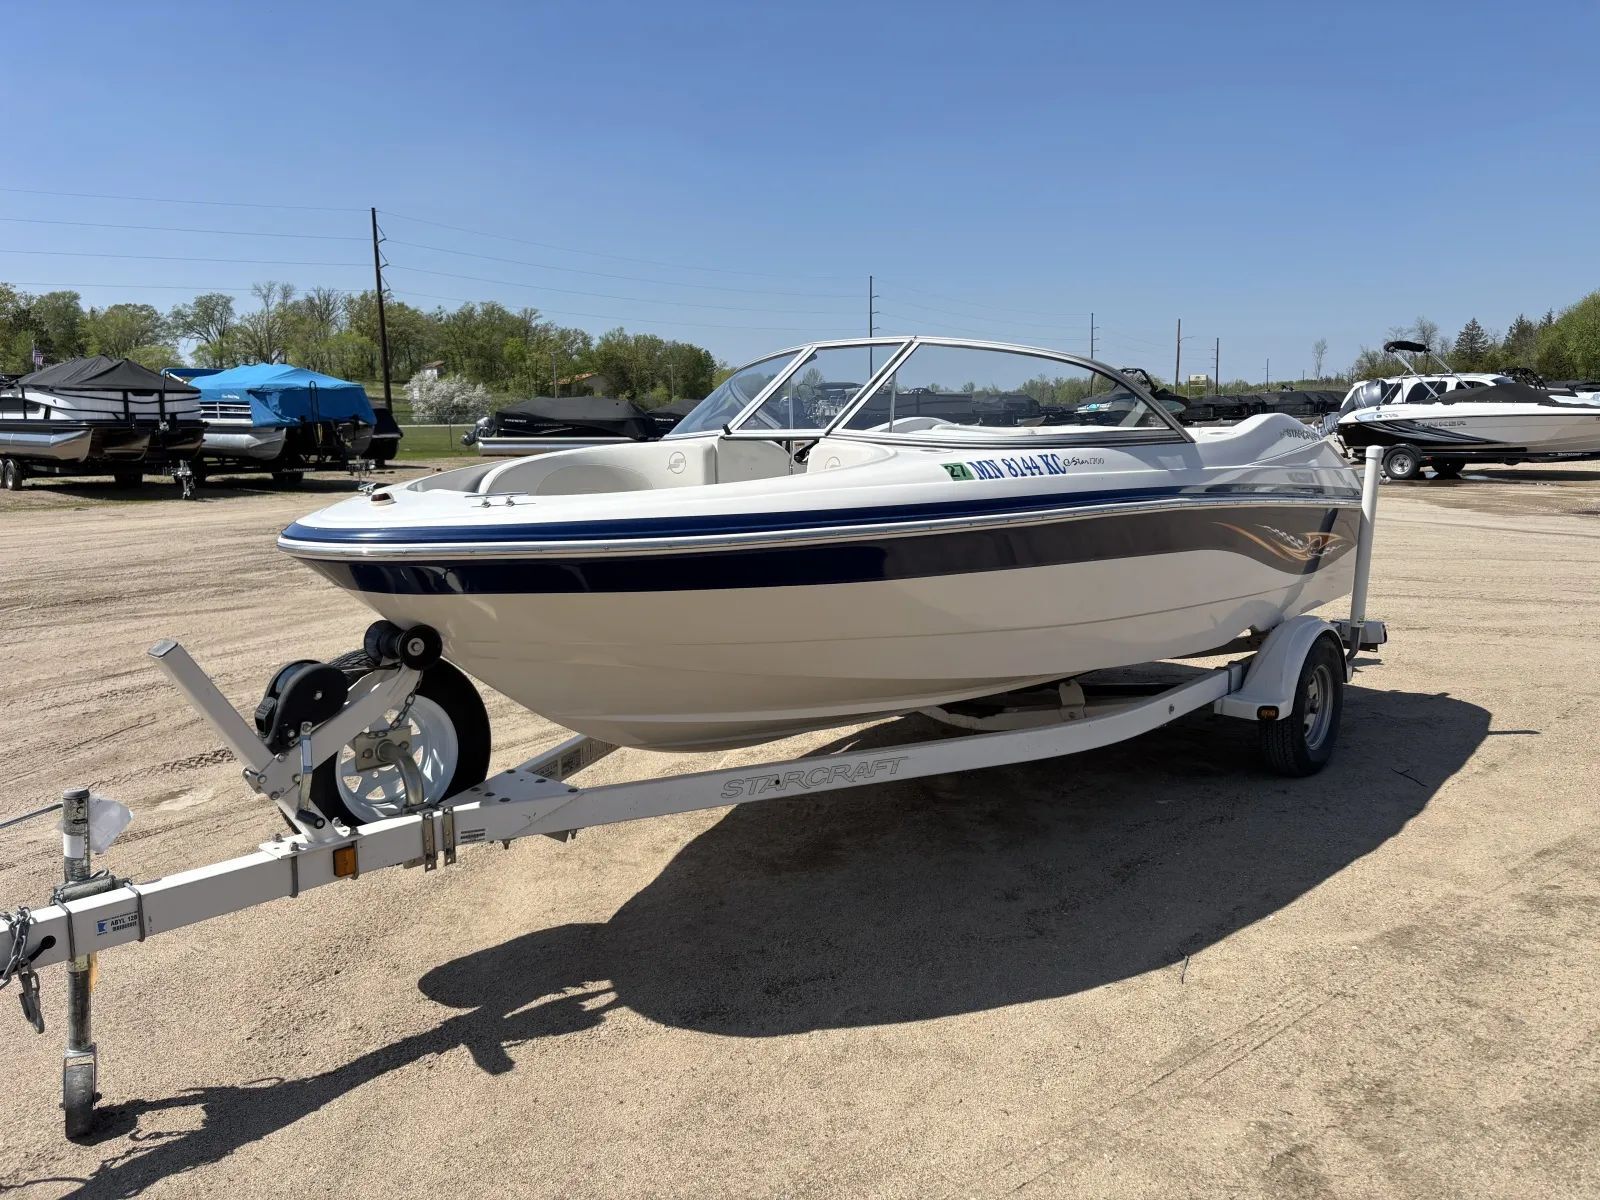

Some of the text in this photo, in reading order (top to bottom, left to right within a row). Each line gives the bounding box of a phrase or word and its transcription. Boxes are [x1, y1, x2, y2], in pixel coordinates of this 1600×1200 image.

[944, 453, 1067, 480] 27 MN 8144 KC
[720, 756, 909, 799] STARCRAFT
